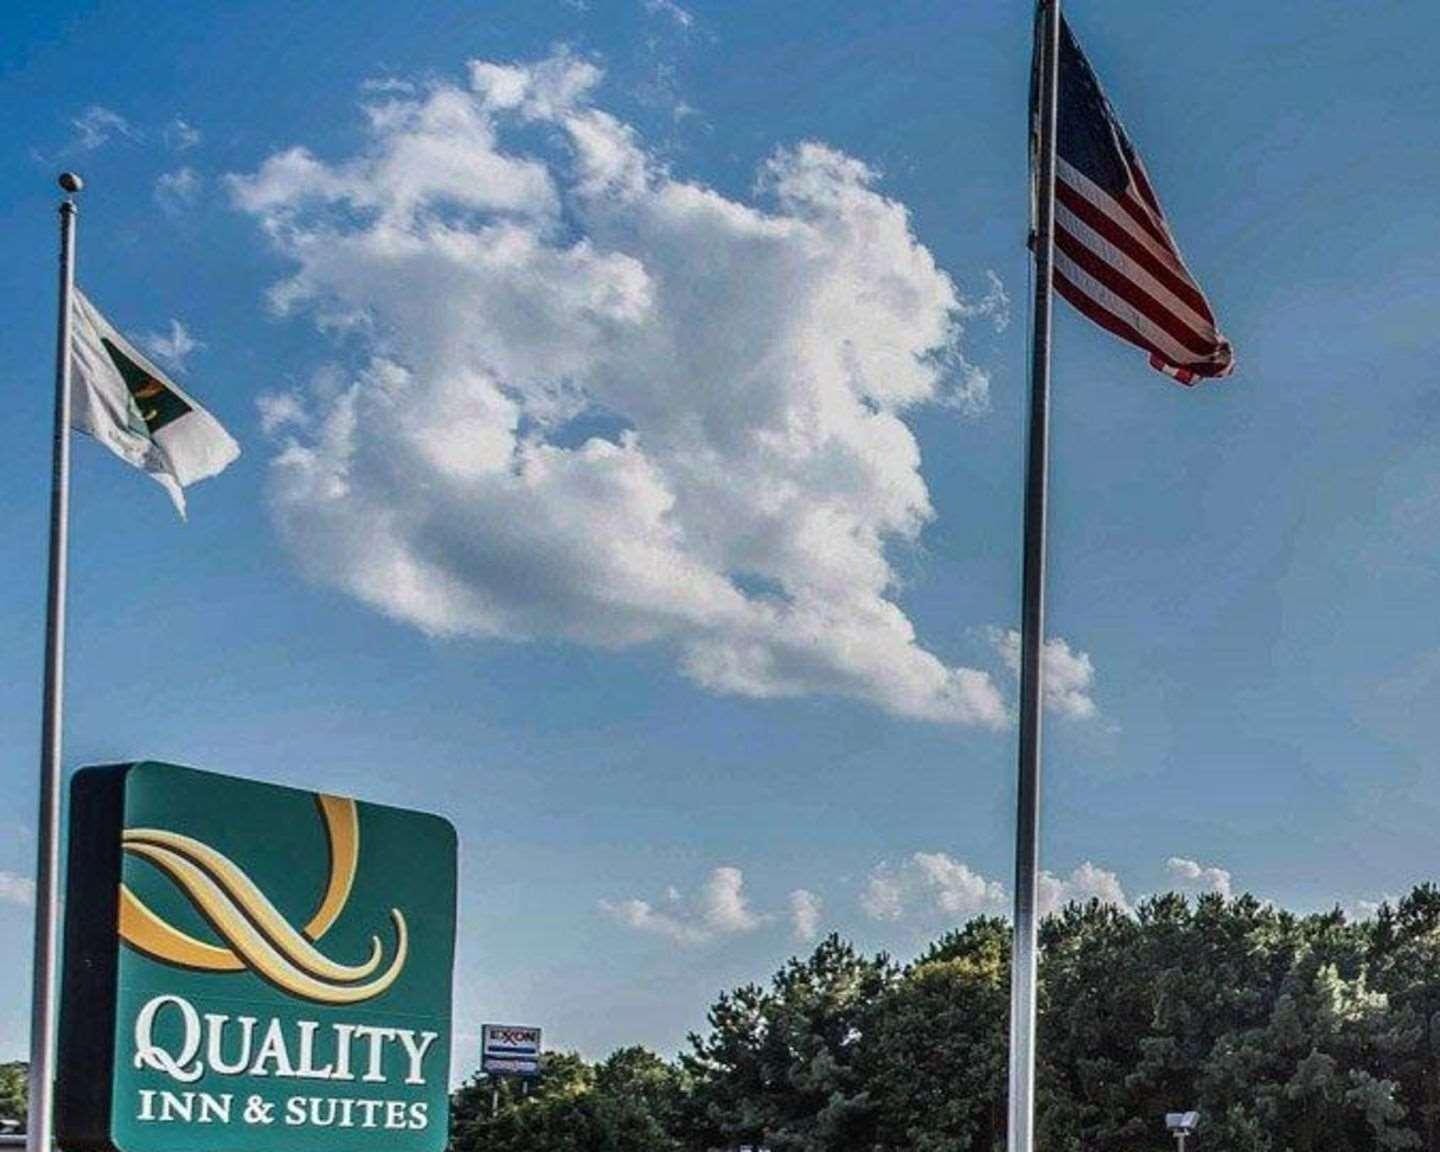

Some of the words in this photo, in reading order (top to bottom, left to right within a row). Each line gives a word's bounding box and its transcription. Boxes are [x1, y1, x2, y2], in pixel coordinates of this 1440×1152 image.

[134, 995, 437, 1084] QUALITY
[138, 1089, 233, 1123] INN
[244, 1095, 275, 1124] &
[285, 1096, 428, 1130] SUITES
